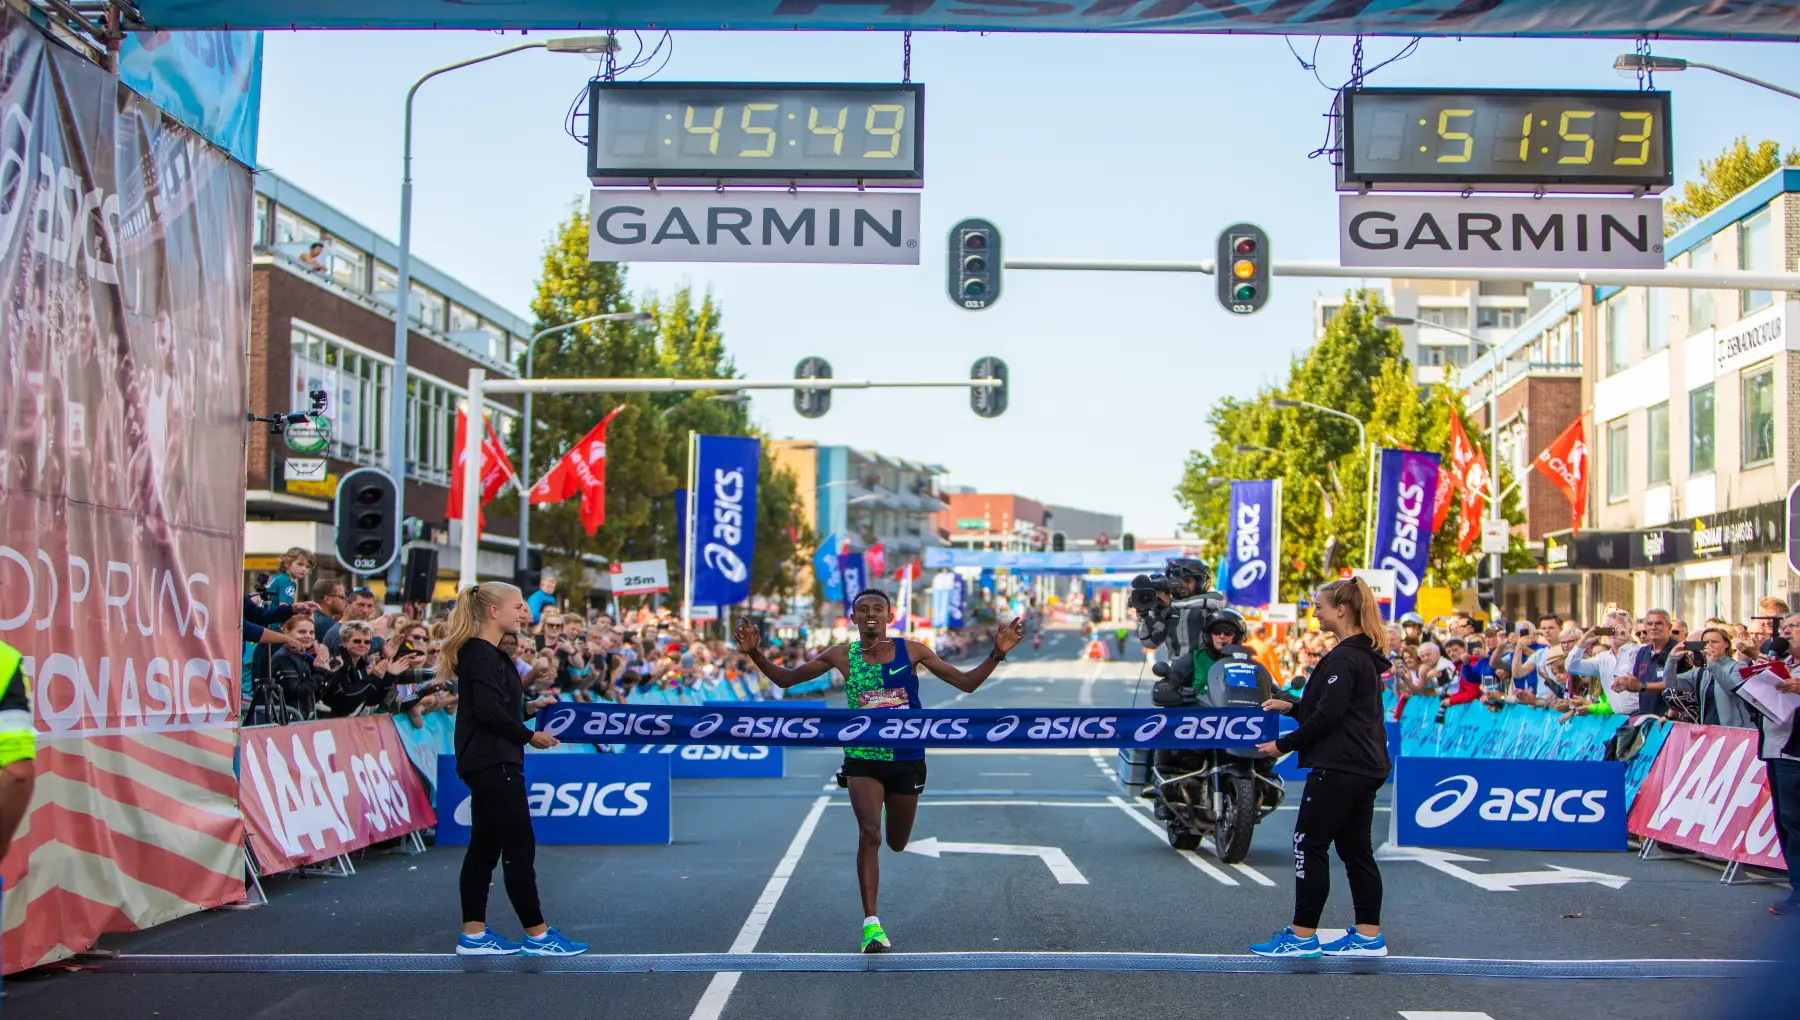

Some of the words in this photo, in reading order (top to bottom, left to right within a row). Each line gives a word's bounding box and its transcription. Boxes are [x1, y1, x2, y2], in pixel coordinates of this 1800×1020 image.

[596, 205, 902, 248] GARMIN
[1348, 210, 1649, 253] GARMIN
[713, 468, 743, 546] asics
[1391, 481, 1424, 561] asics
[106, 560, 210, 640] RUNS
[624, 576, 656, 587] 25m
[121, 656, 237, 727] ASICS
[583, 712, 674, 736] asics
[730, 716, 821, 739] asics
[878, 718, 969, 740] asics
[1027, 716, 1118, 740] asics
[1174, 716, 1265, 741] asics
[1479, 787, 1608, 823] asics
[1647, 734, 1782, 858] IAAF.O
